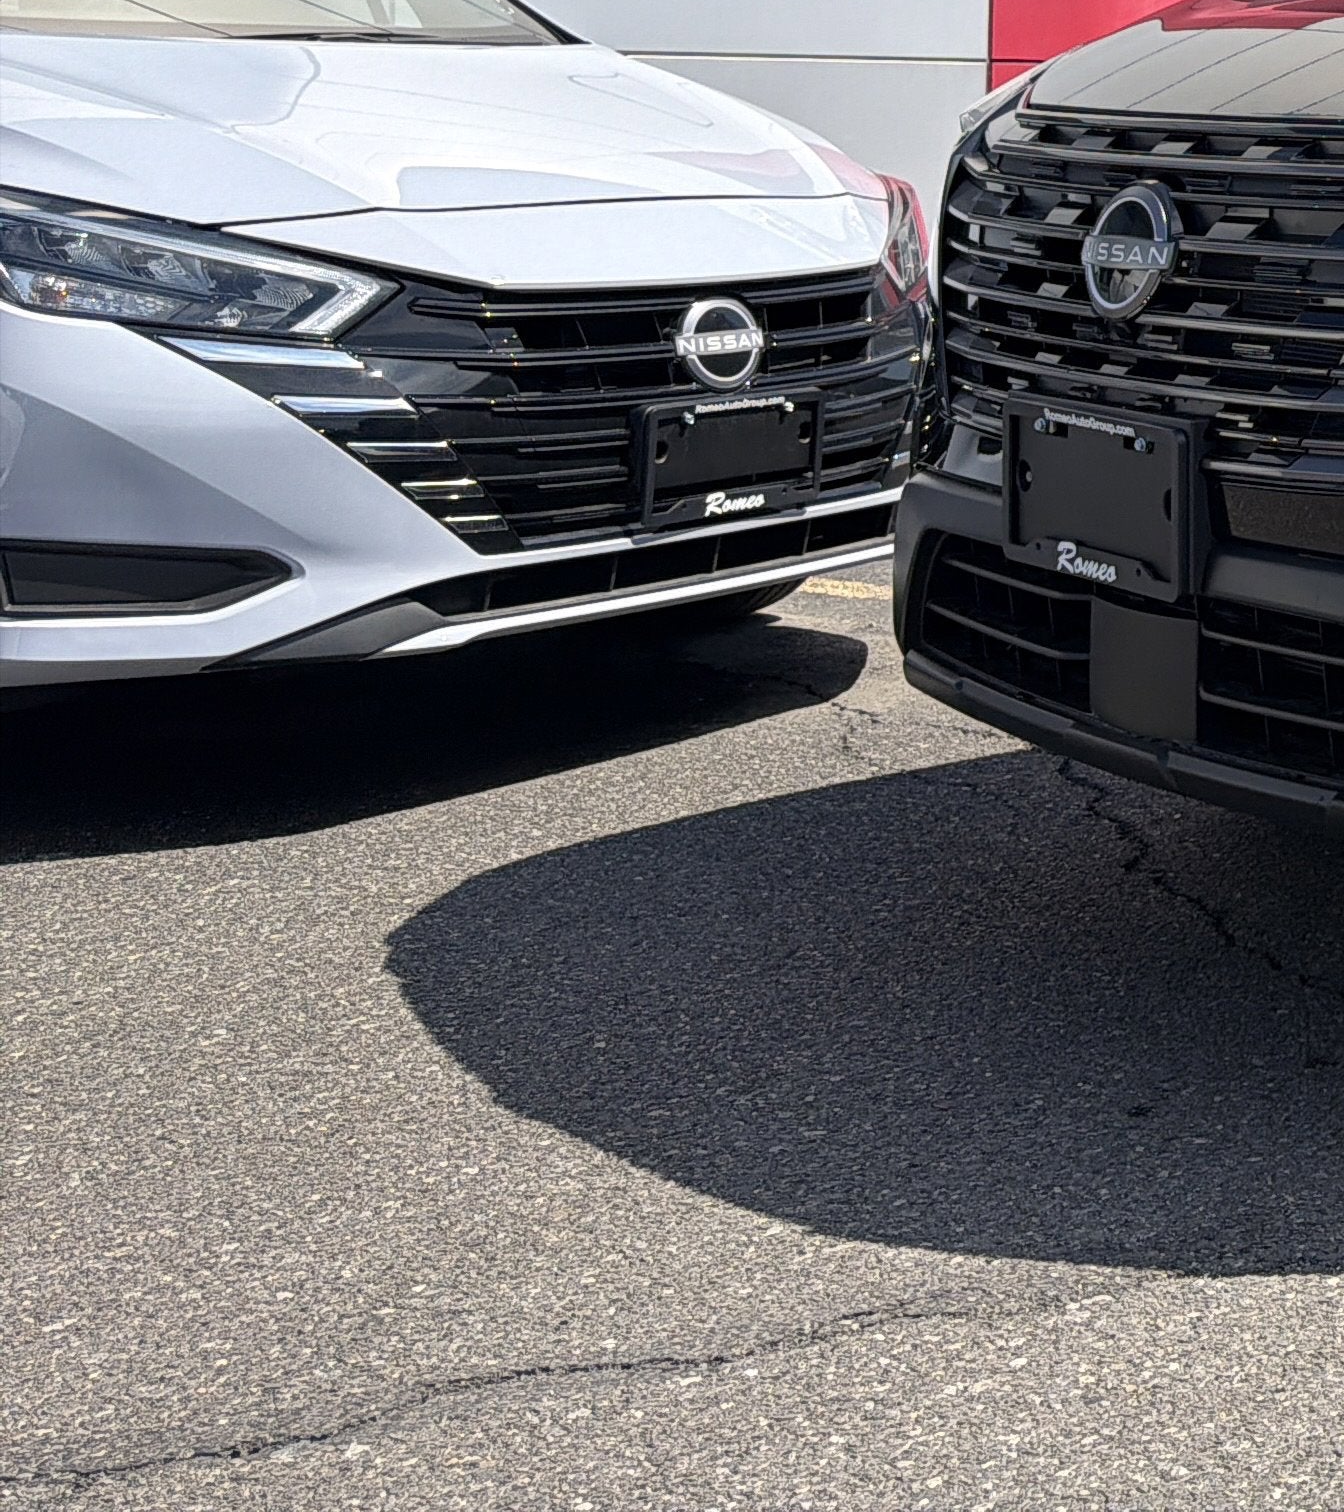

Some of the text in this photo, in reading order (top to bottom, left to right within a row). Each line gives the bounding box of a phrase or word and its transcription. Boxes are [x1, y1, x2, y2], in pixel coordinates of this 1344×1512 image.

[678, 331, 764, 355] NISSAN
[694, 396, 786, 415] RomeoAutoGroup.com
[1043, 407, 1136, 438] RomeoAutoGroup.com
[704, 491, 766, 518] Romeo
[1056, 540, 1117, 583] Romeo
